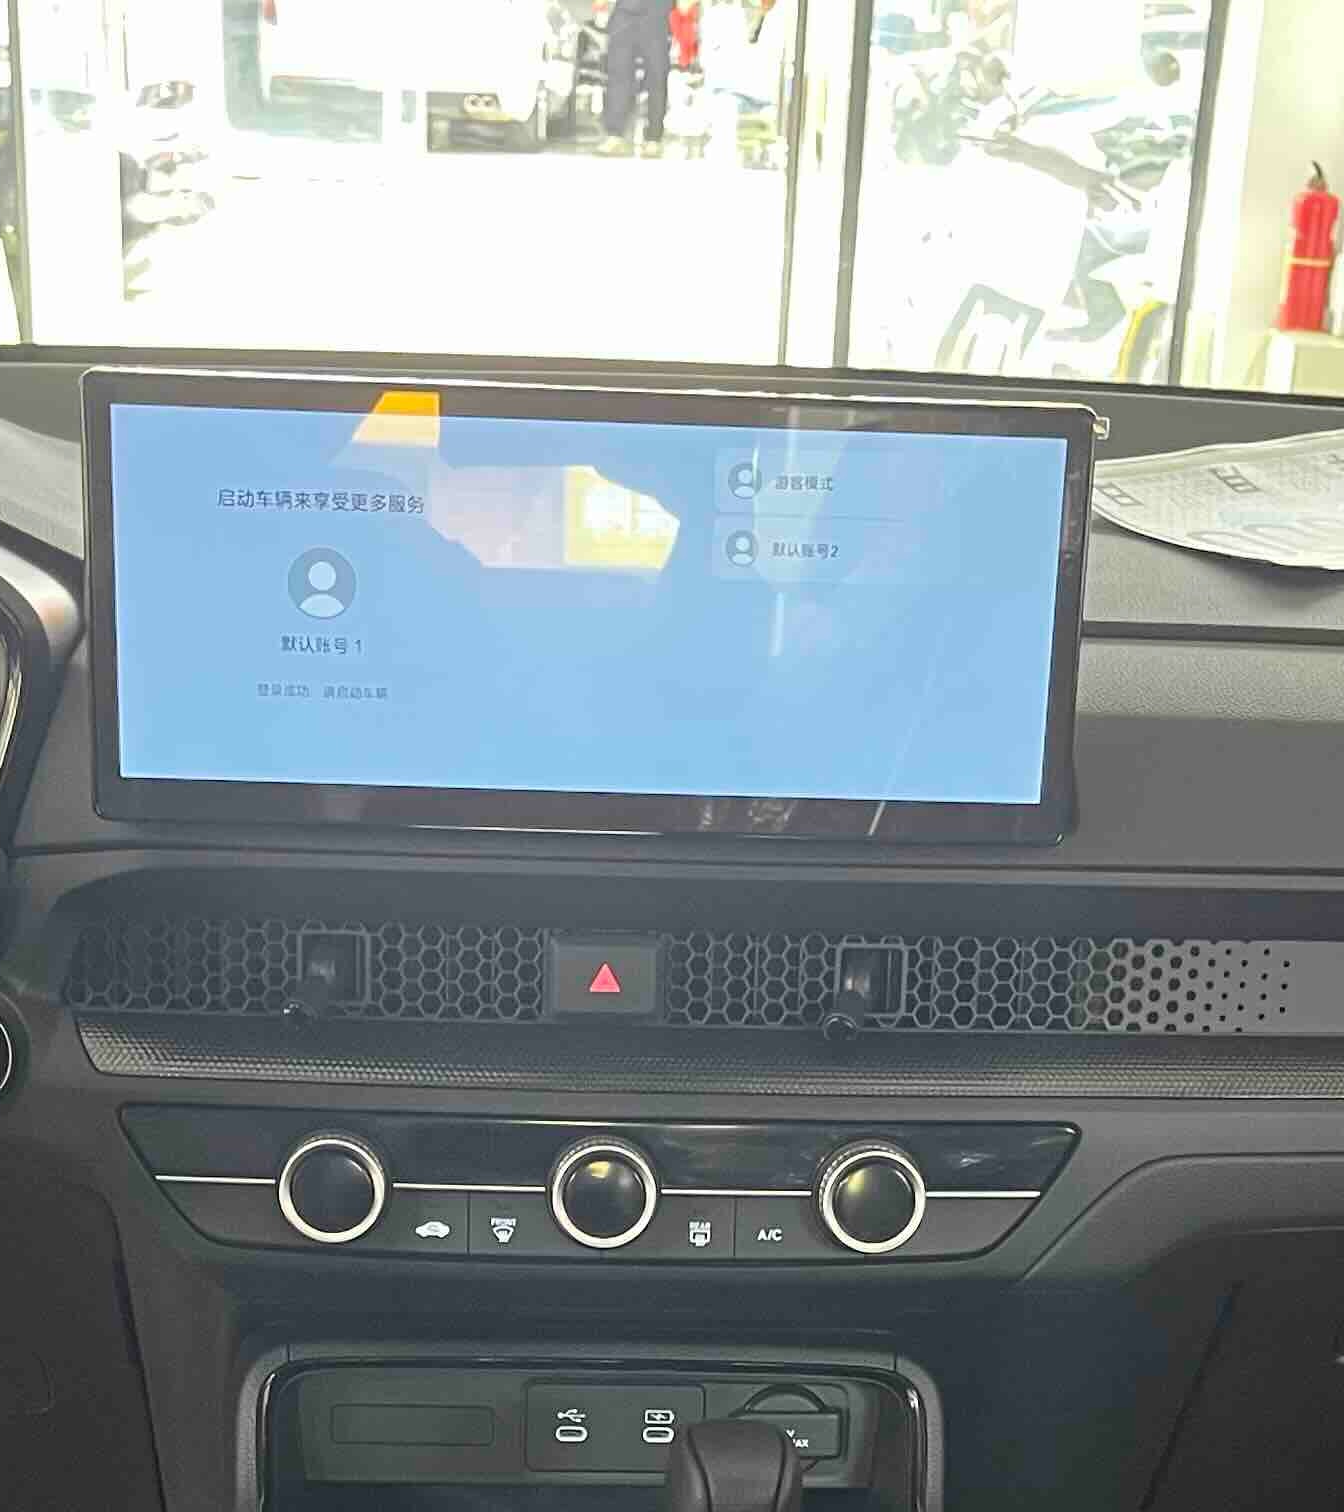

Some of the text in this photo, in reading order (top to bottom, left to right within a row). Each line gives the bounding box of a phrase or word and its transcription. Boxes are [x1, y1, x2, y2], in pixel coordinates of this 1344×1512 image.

[216, 488, 425, 514] 启动车辆来享受更多服务
[757, 1228, 783, 1241] A/C
